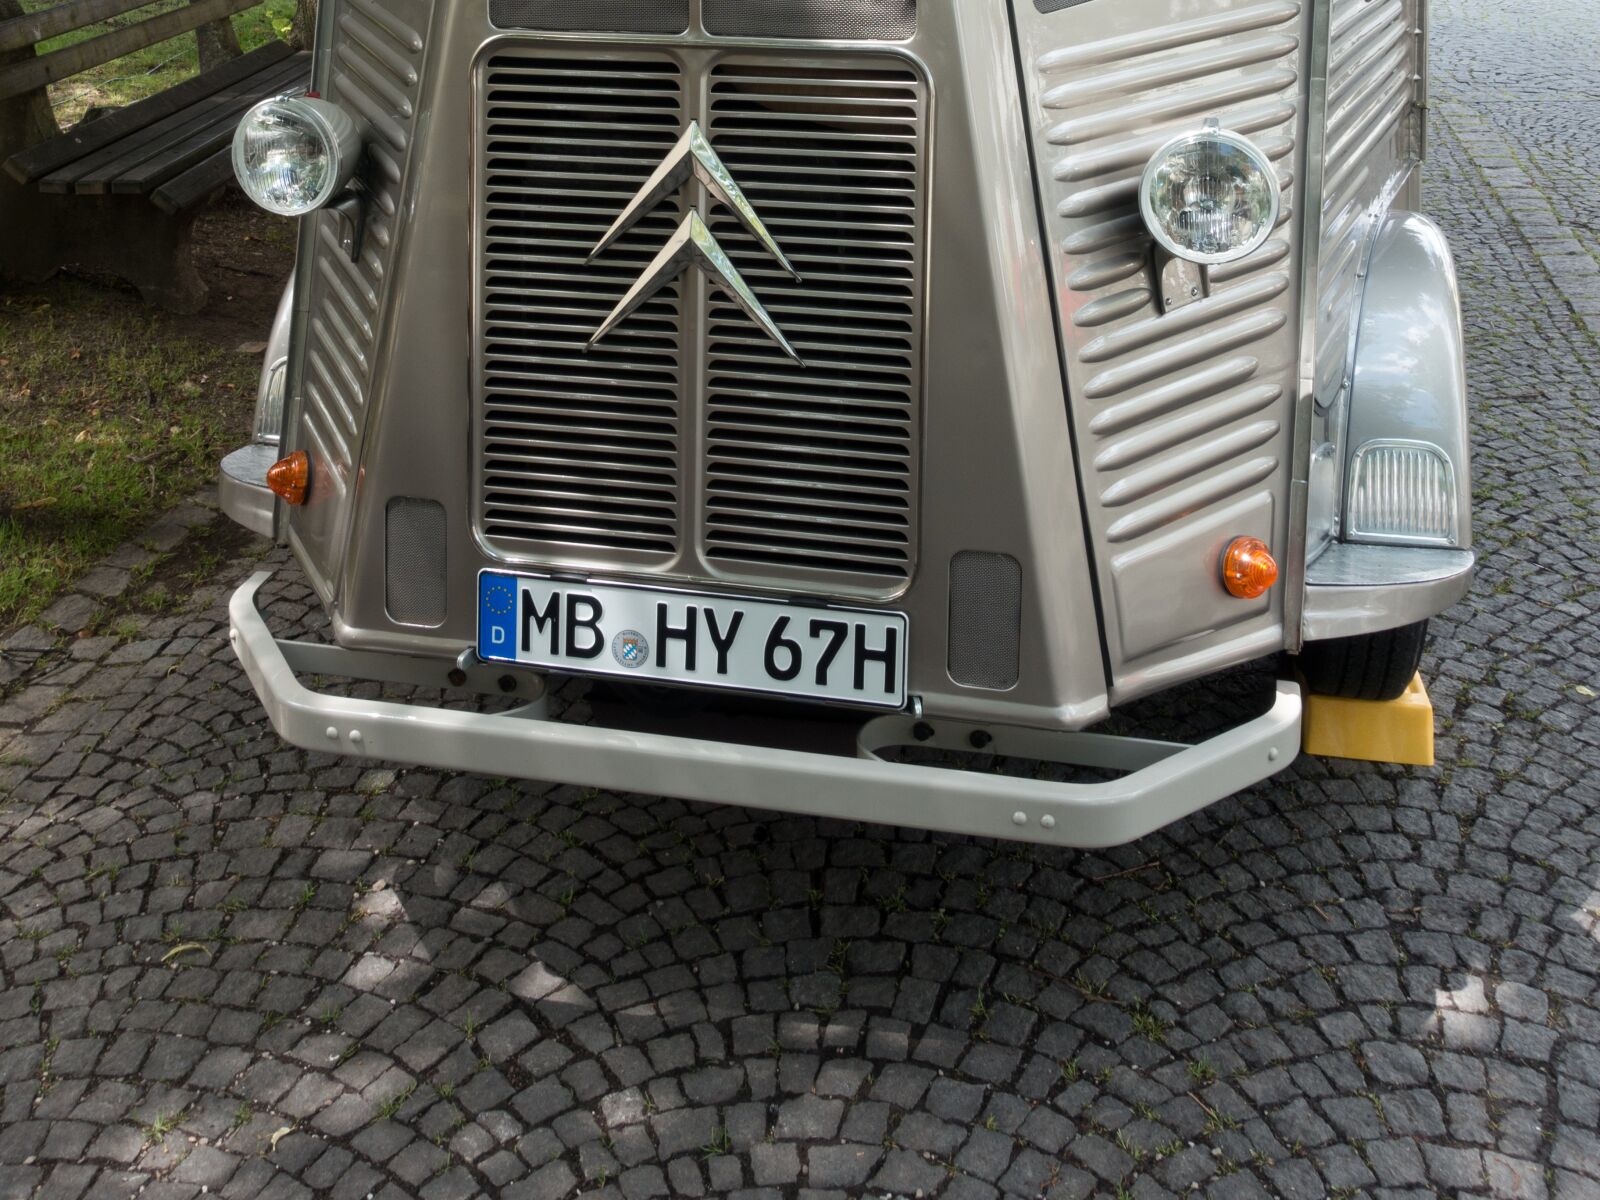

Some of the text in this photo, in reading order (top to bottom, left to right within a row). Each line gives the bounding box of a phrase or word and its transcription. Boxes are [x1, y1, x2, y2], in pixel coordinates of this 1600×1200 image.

[491, 626, 505, 644] D
[521, 588, 603, 659] MB
[655, 602, 744, 674] HY
[764, 615, 897, 694] 67H
